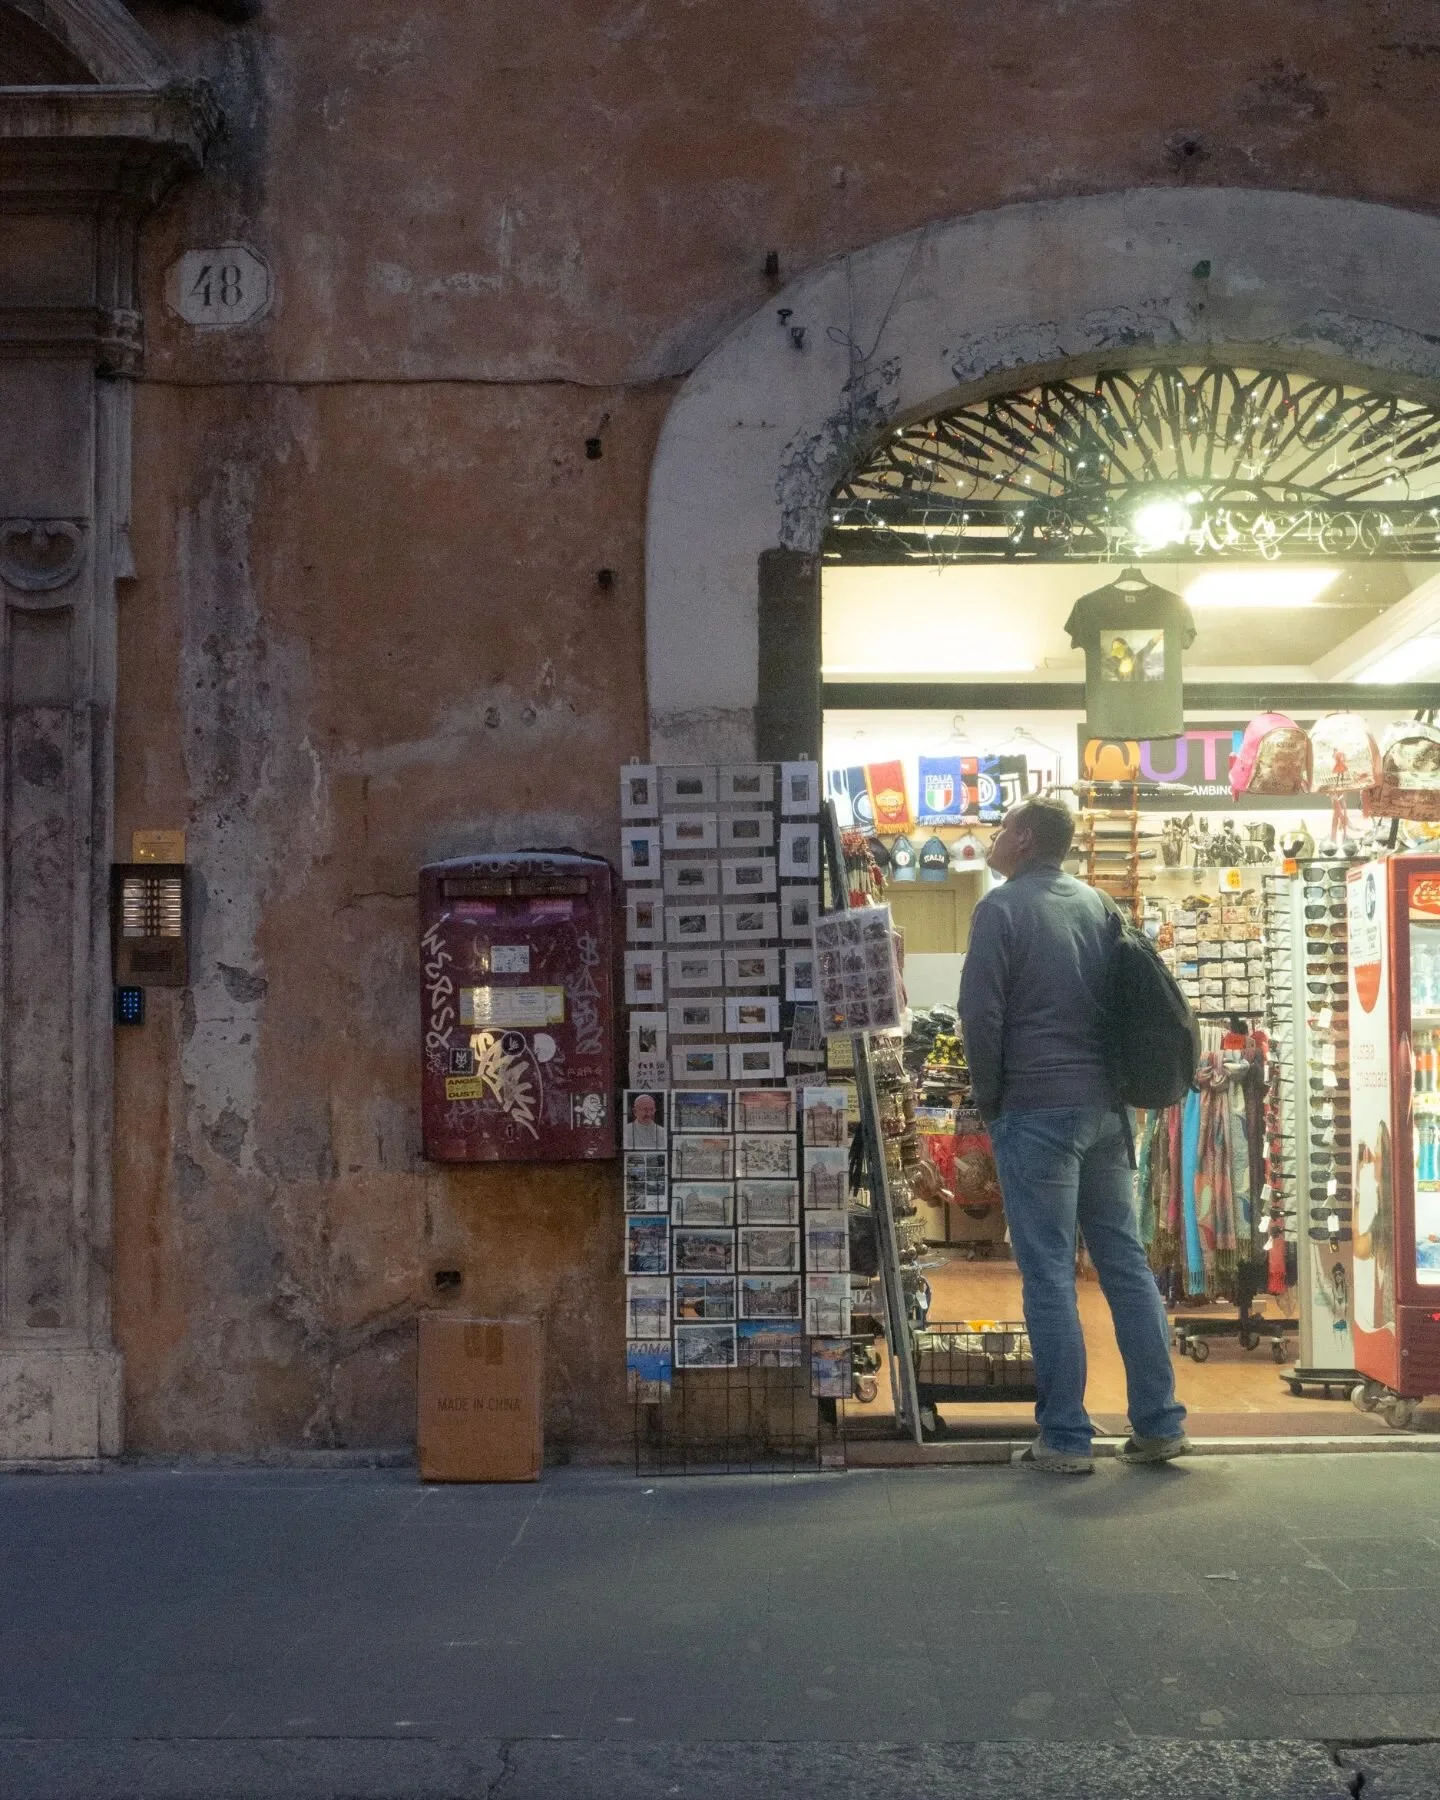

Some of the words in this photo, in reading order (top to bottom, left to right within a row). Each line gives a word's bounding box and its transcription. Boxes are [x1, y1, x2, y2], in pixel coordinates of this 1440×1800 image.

[188, 264, 244, 307] 48
[926, 774, 953, 783] ITALIA
[923, 853, 945, 864] ITALIA
[472, 859, 555, 873] POSTE
[629, 1342, 670, 1355] ROMA
[437, 1398, 469, 1412] MADE
[473, 1398, 484, 1412] IN
[486, 1398, 521, 1412] CHINA
